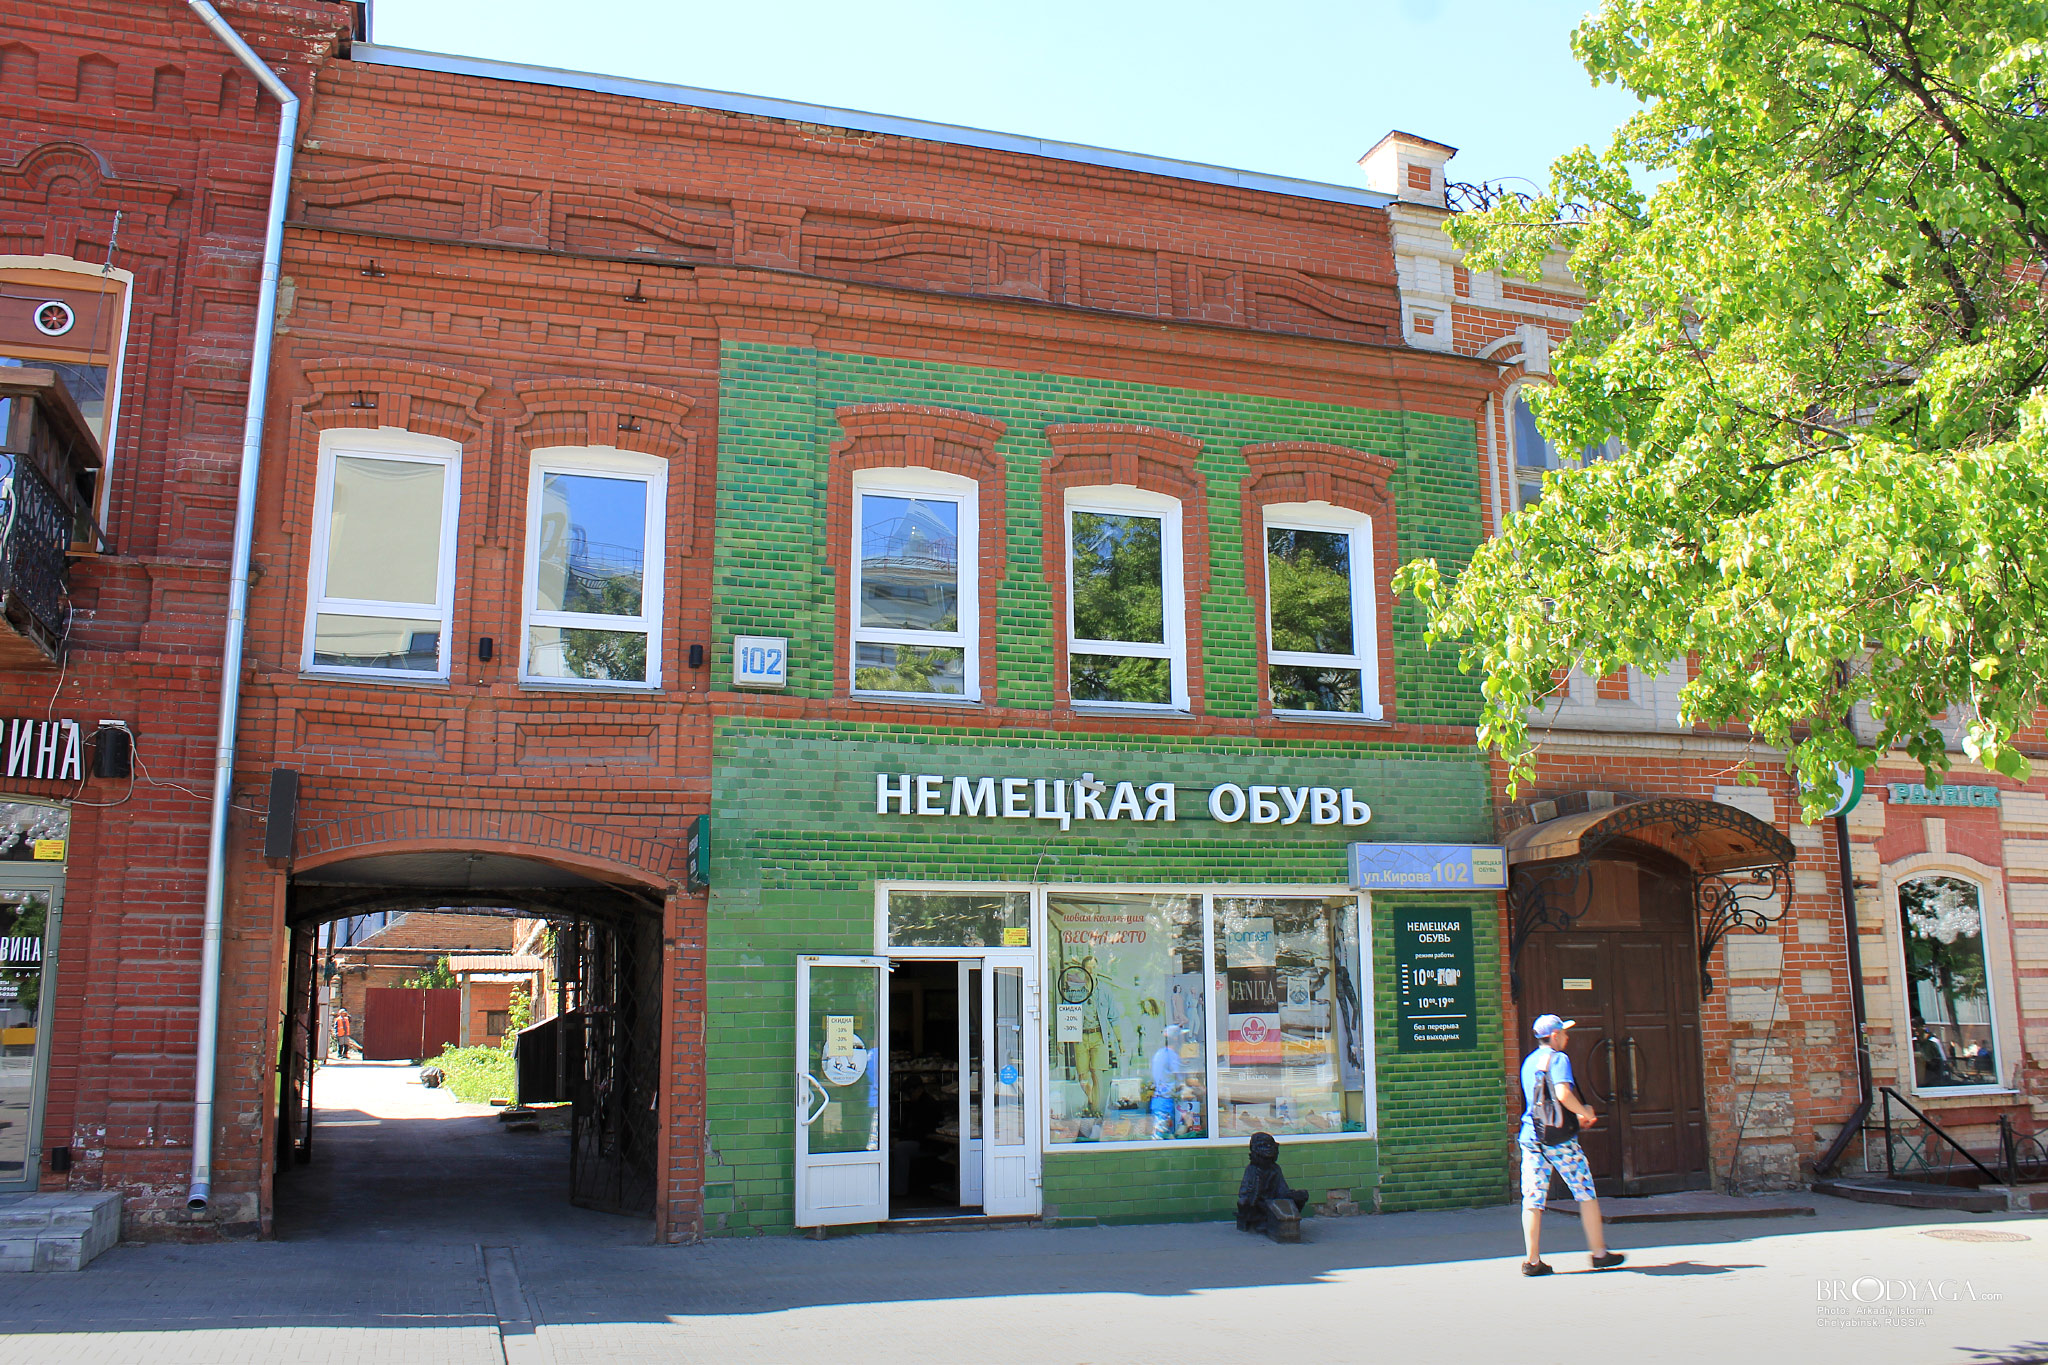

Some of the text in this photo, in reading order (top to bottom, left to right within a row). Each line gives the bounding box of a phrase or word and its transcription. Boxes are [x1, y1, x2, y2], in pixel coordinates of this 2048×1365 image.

[741, 646, 782, 676] 102
[0, 718, 81, 780] ИНА
[876, 772, 1372, 832] НЕМЕЦКАЯ ОБУВЬ
[1887, 782, 2001, 808] PATRICK
[1363, 862, 1468, 885] ул.Кирова 102
[1407, 921, 1460, 932] НЕМЕЦКАЯ
[1418, 933, 1451, 943] ОБУВЬ
[1434, 951, 1454, 960] работы
[1231, 980, 1275, 1001] JANITA
[1413, 1023, 1459, 1032] без перерыва
[1413, 1033, 1460, 1042] без выходных
